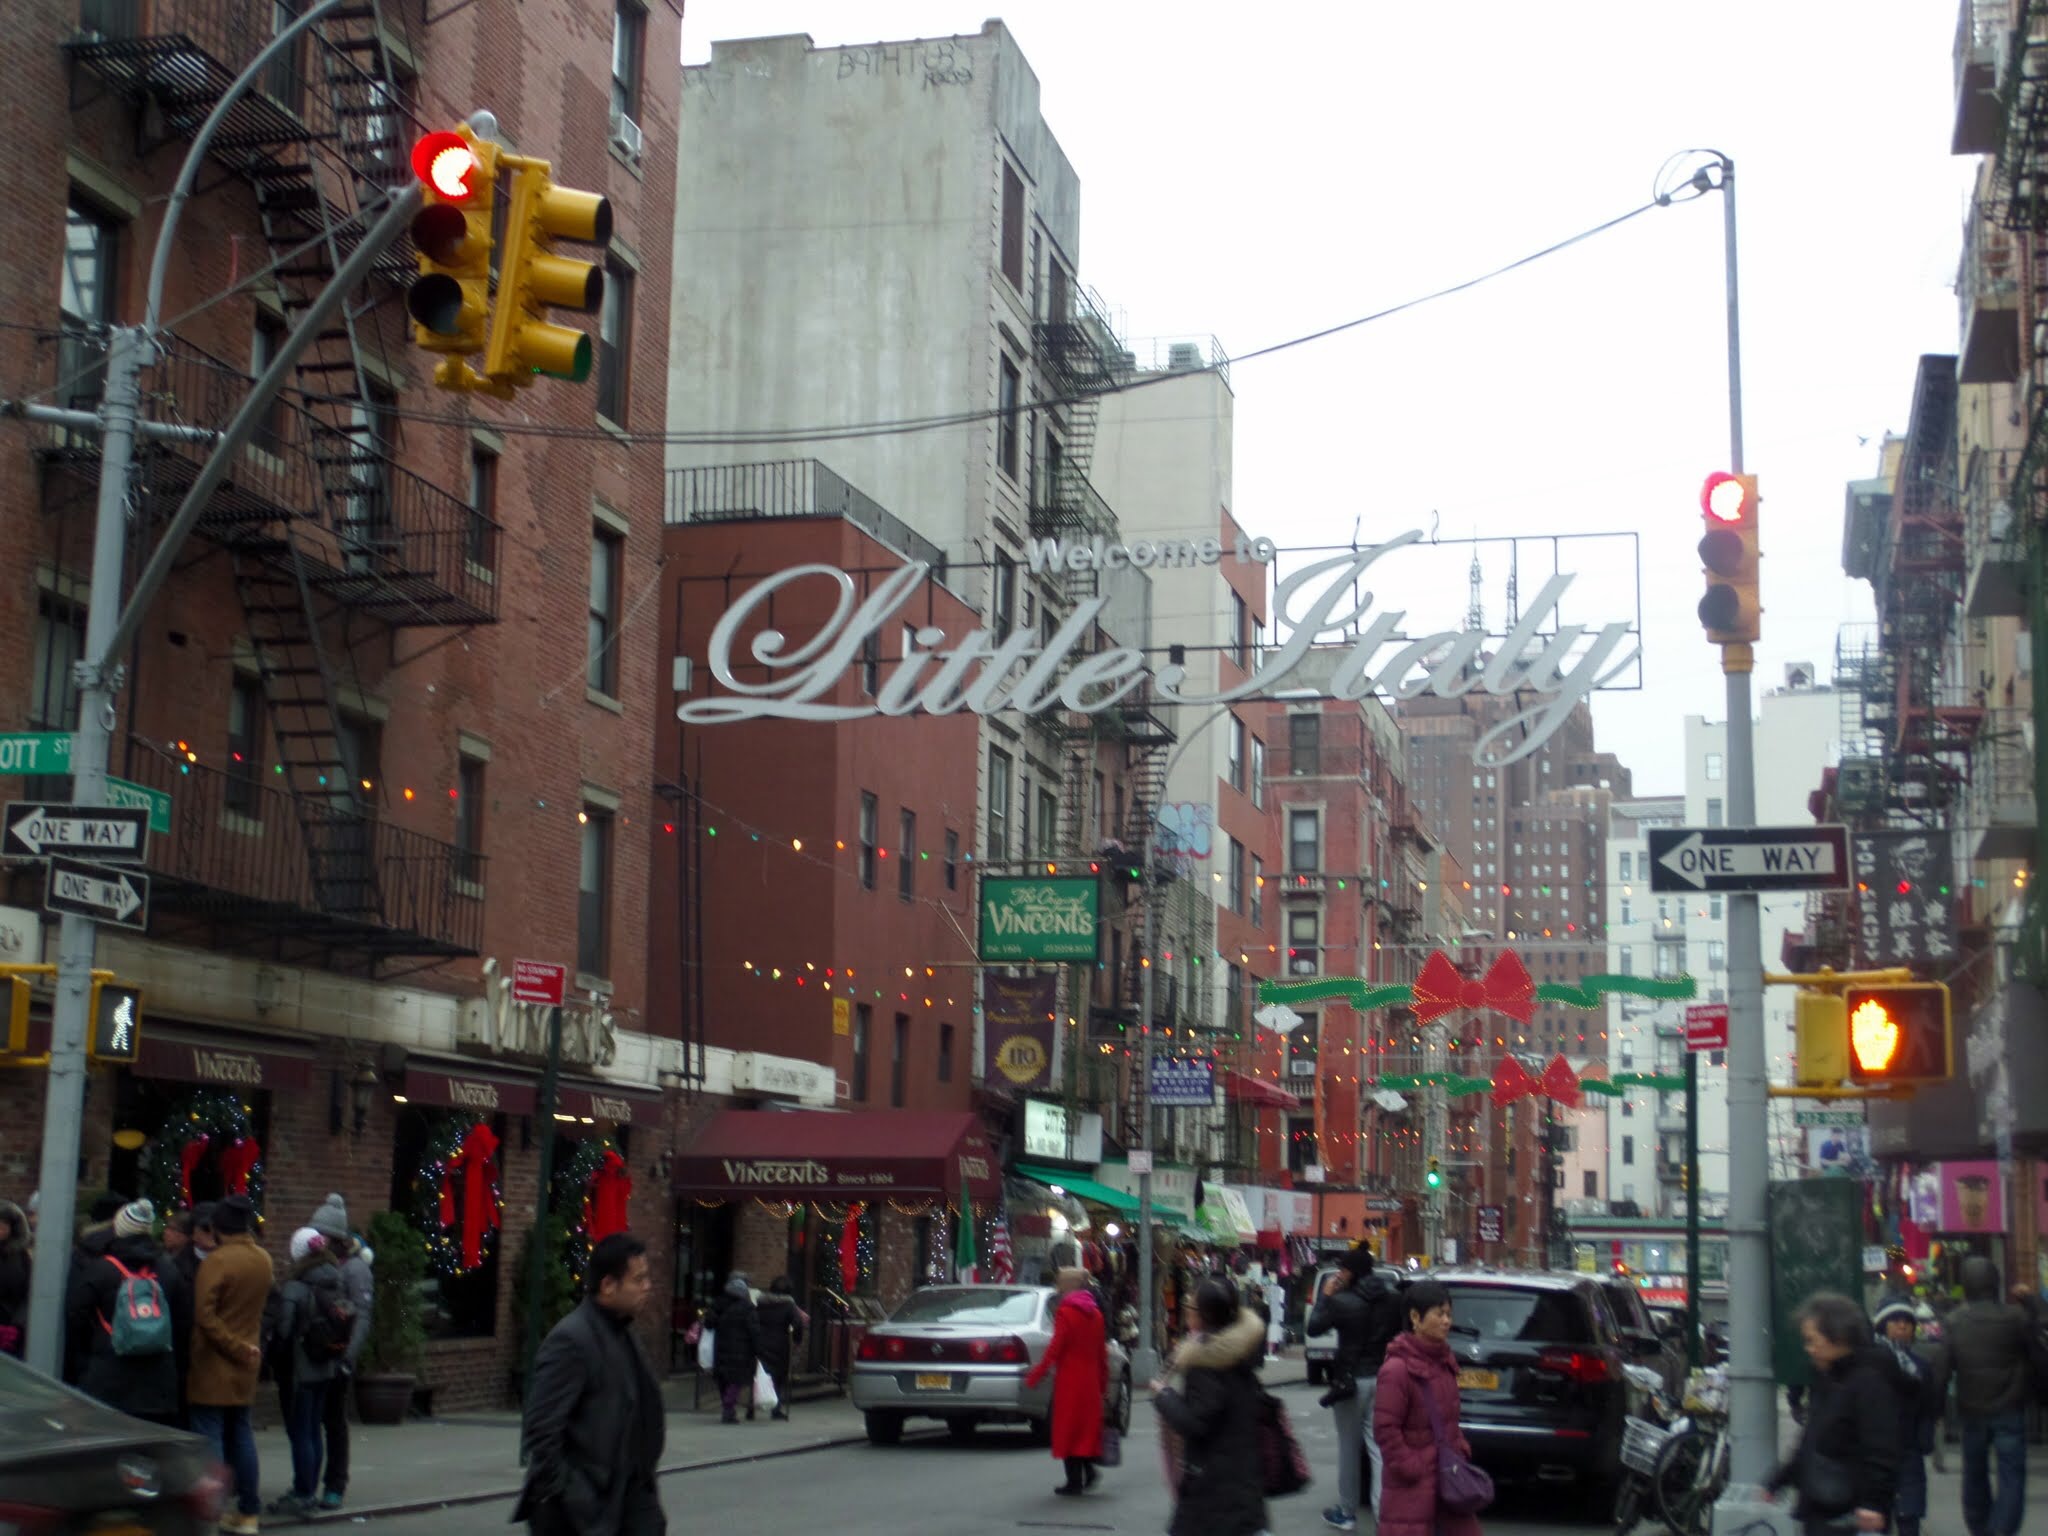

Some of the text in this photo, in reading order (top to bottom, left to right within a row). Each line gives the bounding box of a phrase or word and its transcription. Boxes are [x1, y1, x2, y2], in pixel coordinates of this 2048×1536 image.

[1026, 532, 1275, 573] Welcome to
[677, 529, 1643, 767] Little Italy
[28, 820, 127, 844] ONE WAY
[1680, 847, 1821, 873] ONE WAY
[61, 874, 133, 911] ONE WAY
[837, 1172, 866, 1185] Since
